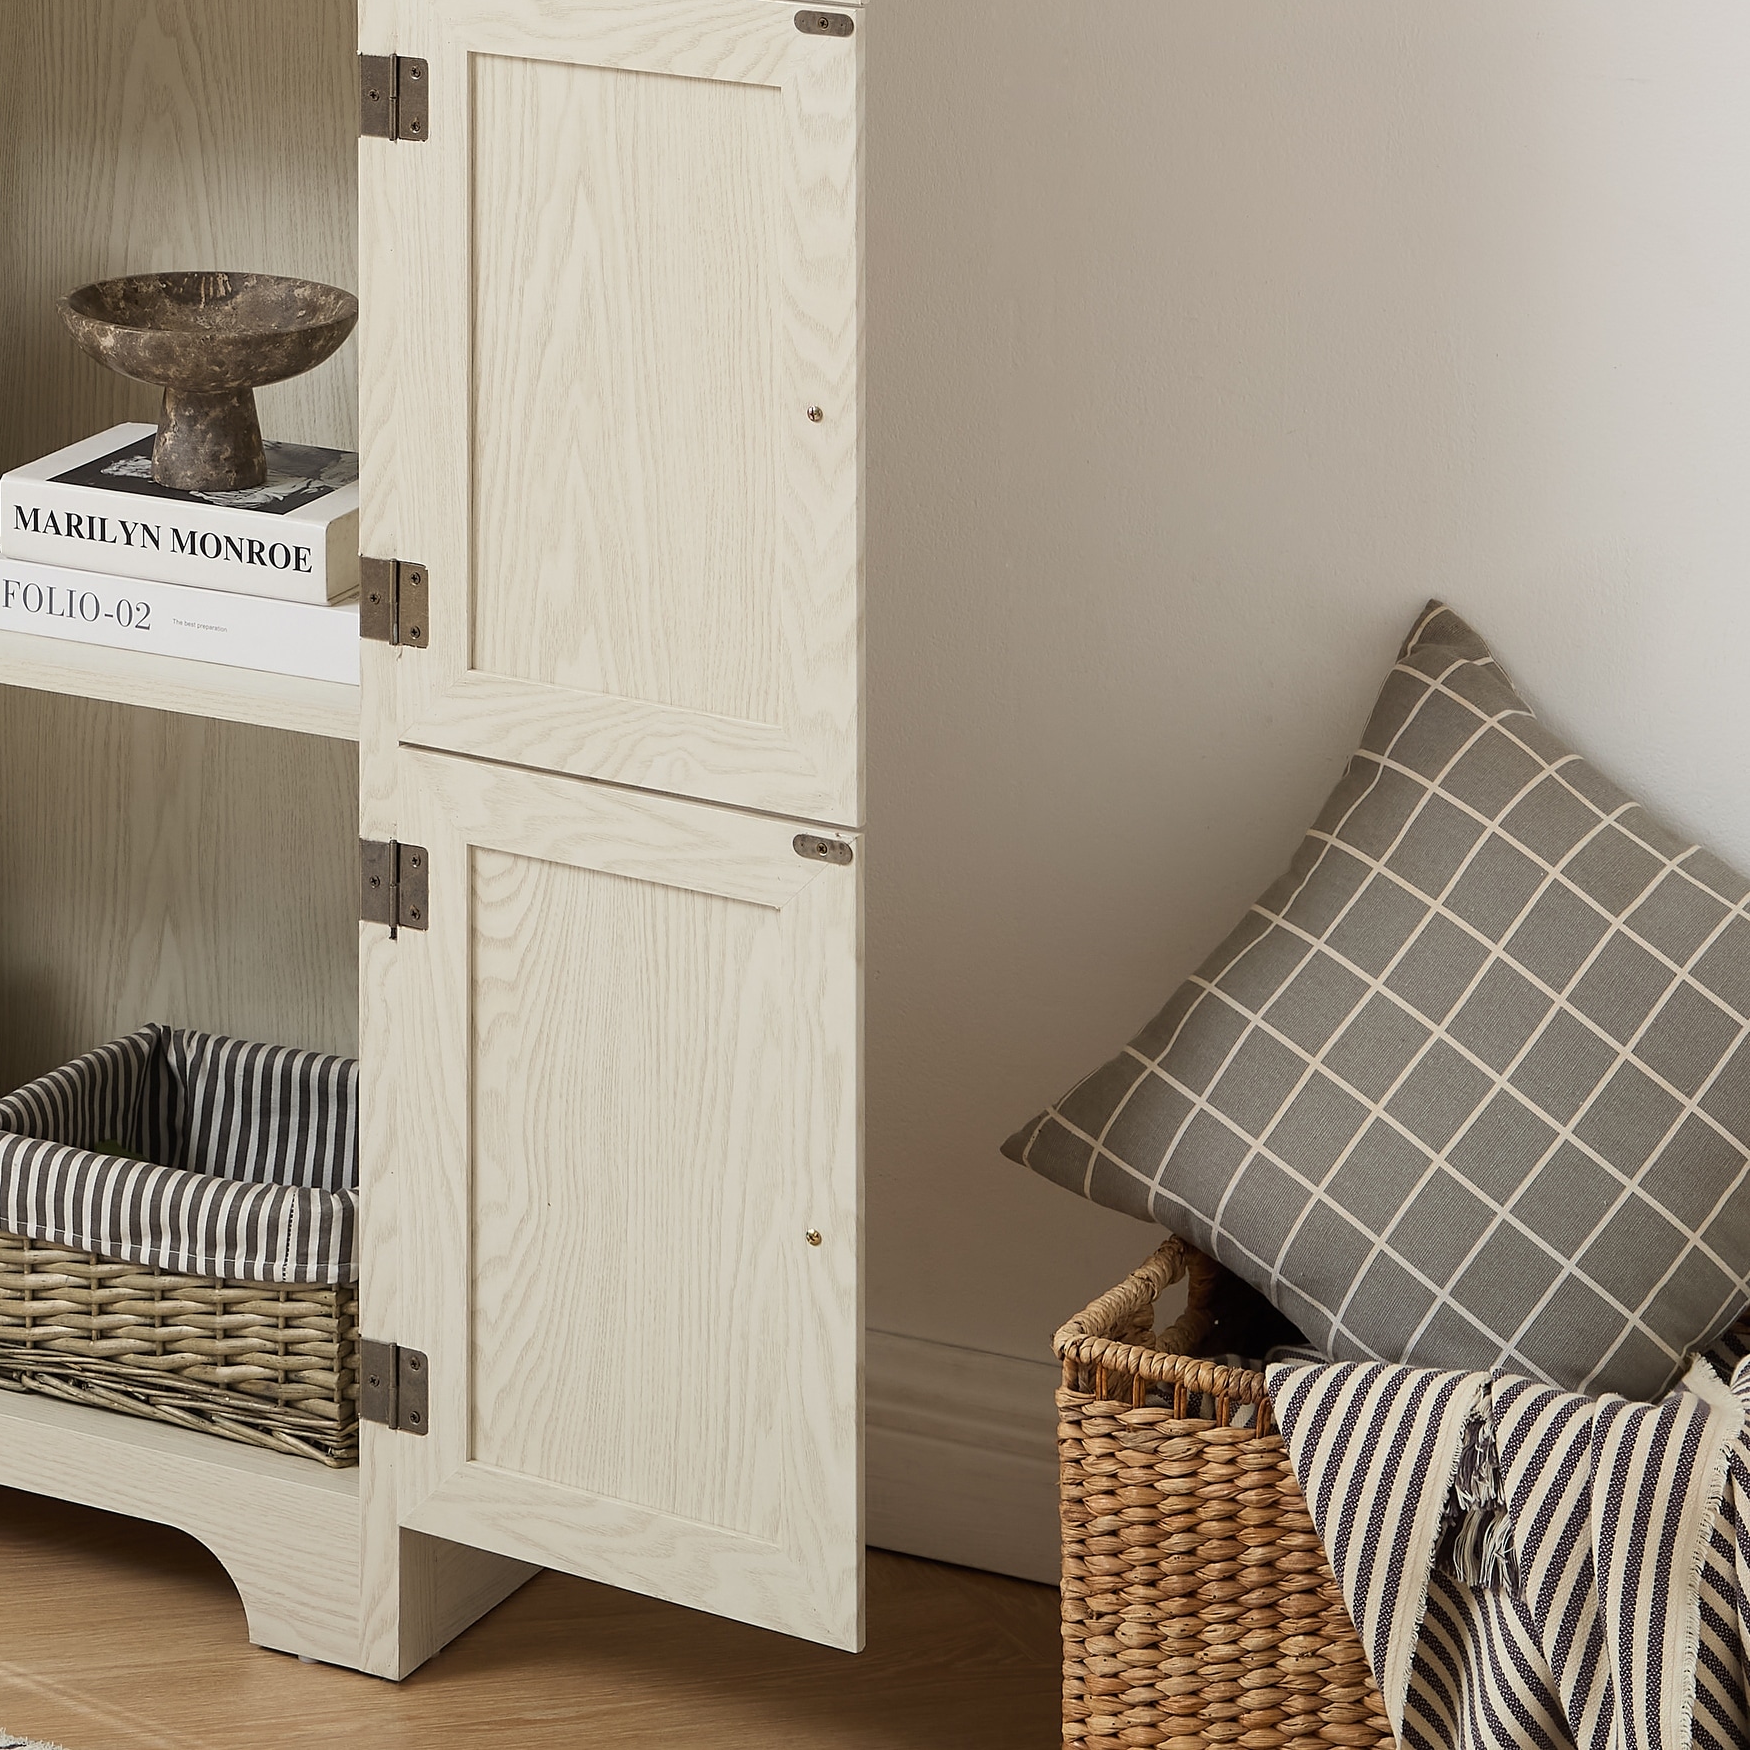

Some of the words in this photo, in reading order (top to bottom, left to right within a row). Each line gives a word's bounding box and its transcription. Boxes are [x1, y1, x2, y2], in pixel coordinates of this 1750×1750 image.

[13, 505, 162, 551] MARILYN
[170, 528, 314, 574] MONROE
[1, 578, 152, 631] FOLIO-02
